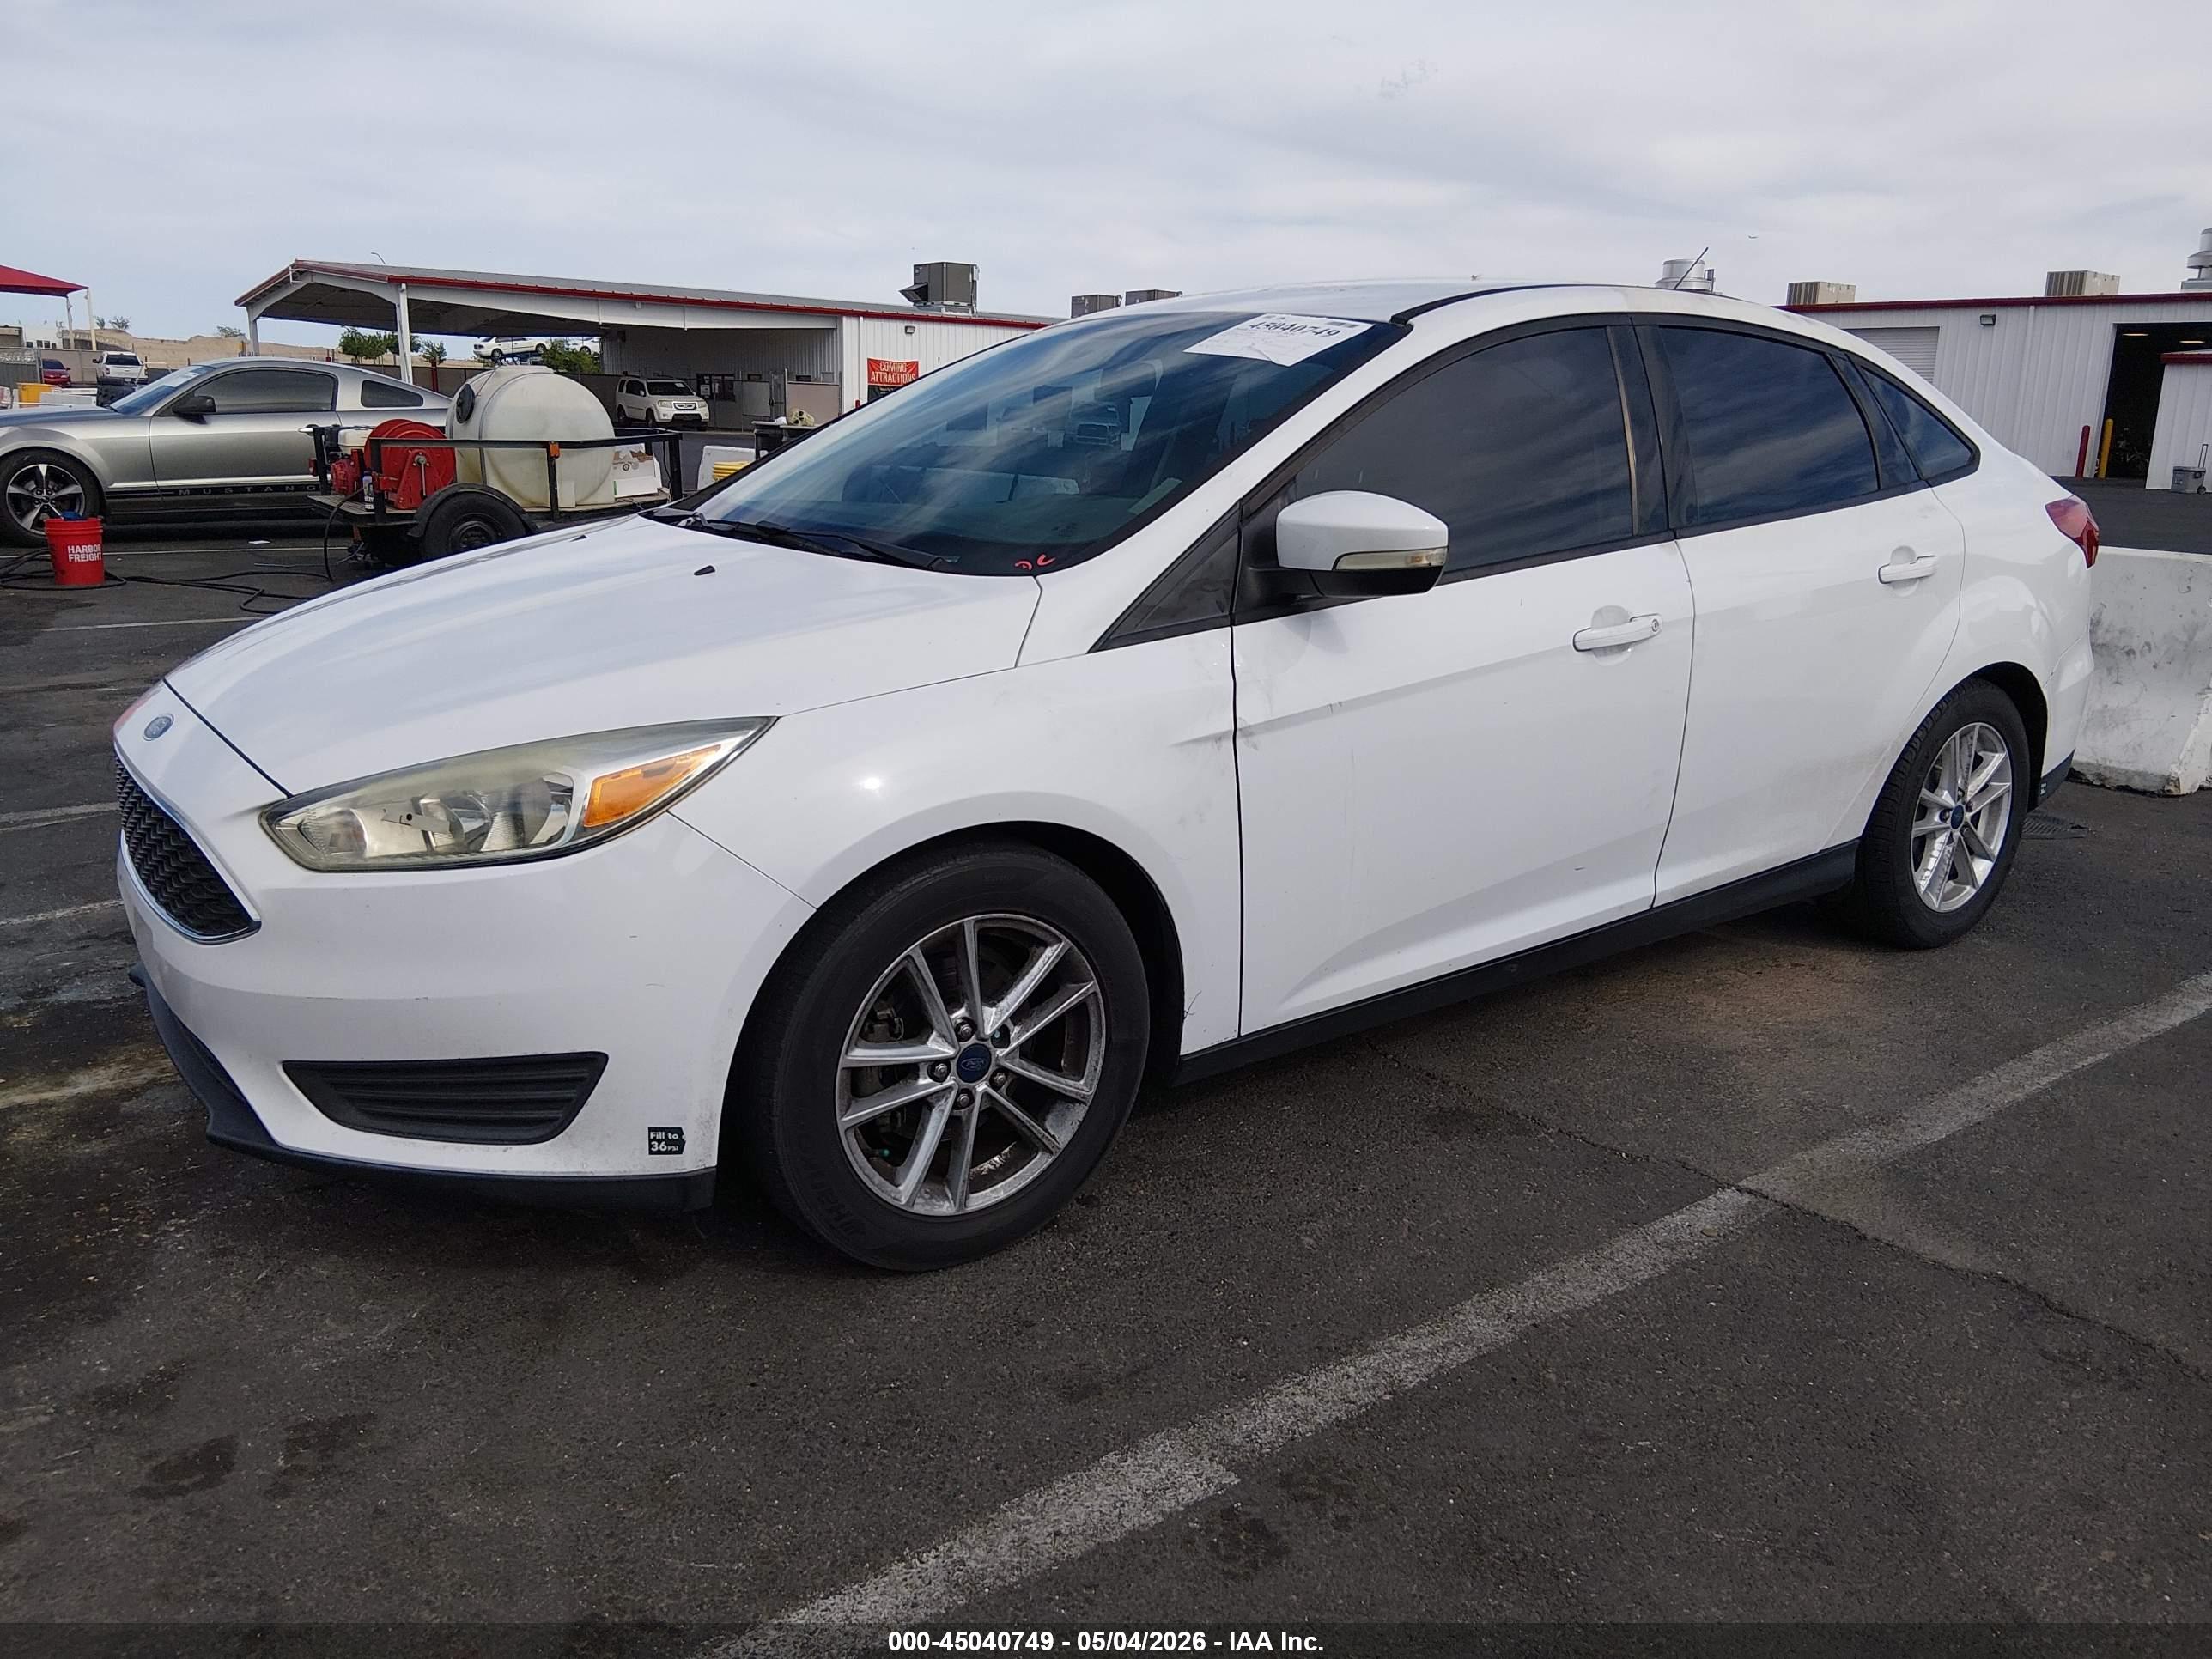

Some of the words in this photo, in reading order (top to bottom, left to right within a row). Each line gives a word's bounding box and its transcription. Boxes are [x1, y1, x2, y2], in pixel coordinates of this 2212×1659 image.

[879, 362, 907, 372] COMING
[871, 371, 915, 384] ATTRACTIONS
[179, 485, 316, 495] MUSTANG
[68, 544, 101, 553] HARBOR
[69, 552, 102, 562] FREIGHT
[649, 1131, 665, 1139] Fill
